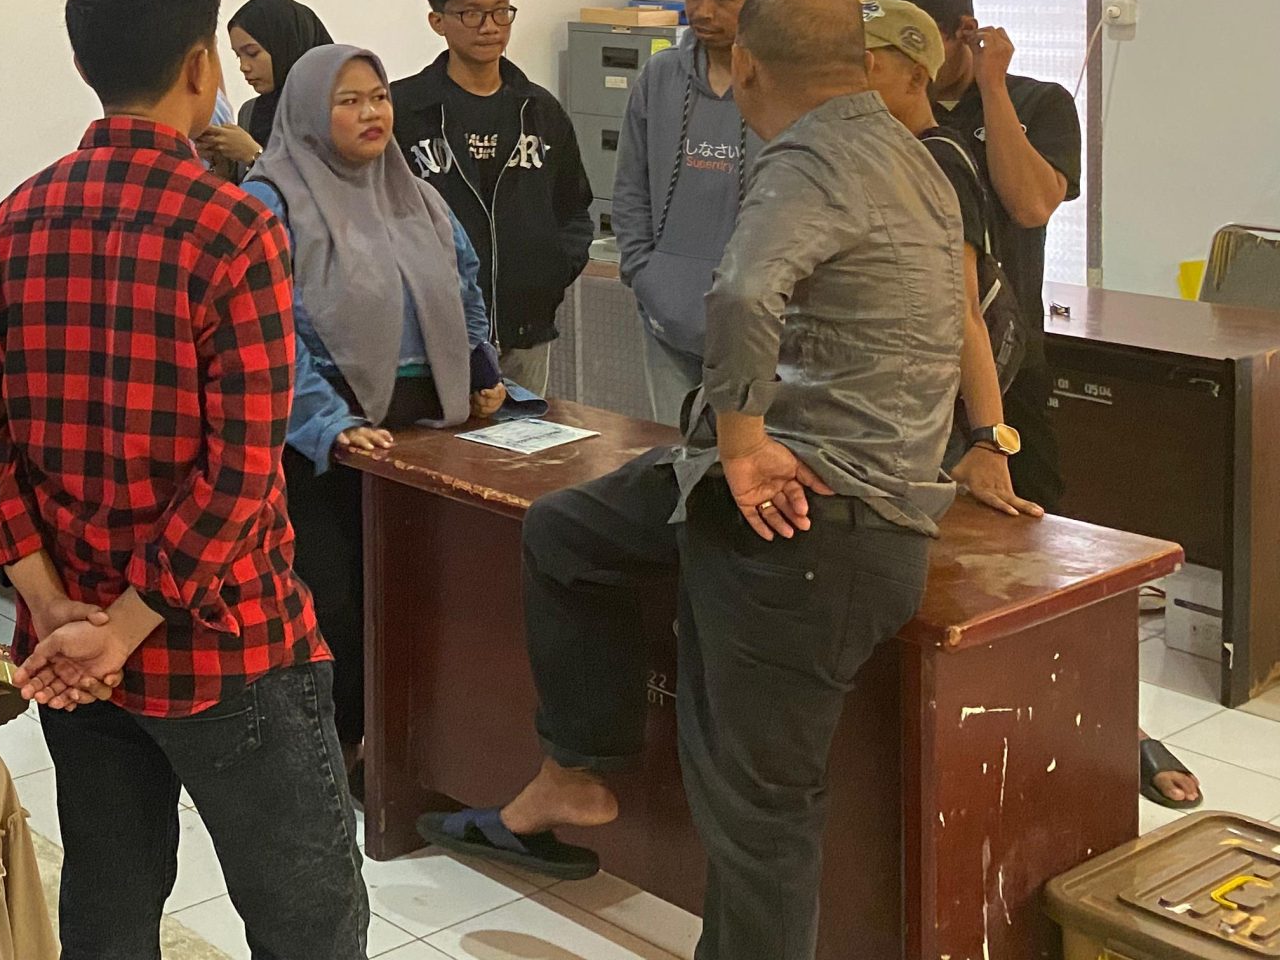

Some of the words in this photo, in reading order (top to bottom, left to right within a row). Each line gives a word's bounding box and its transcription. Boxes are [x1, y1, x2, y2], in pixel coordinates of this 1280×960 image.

[686, 138, 740, 159] しなさい
[648, 670, 667, 689] 22
